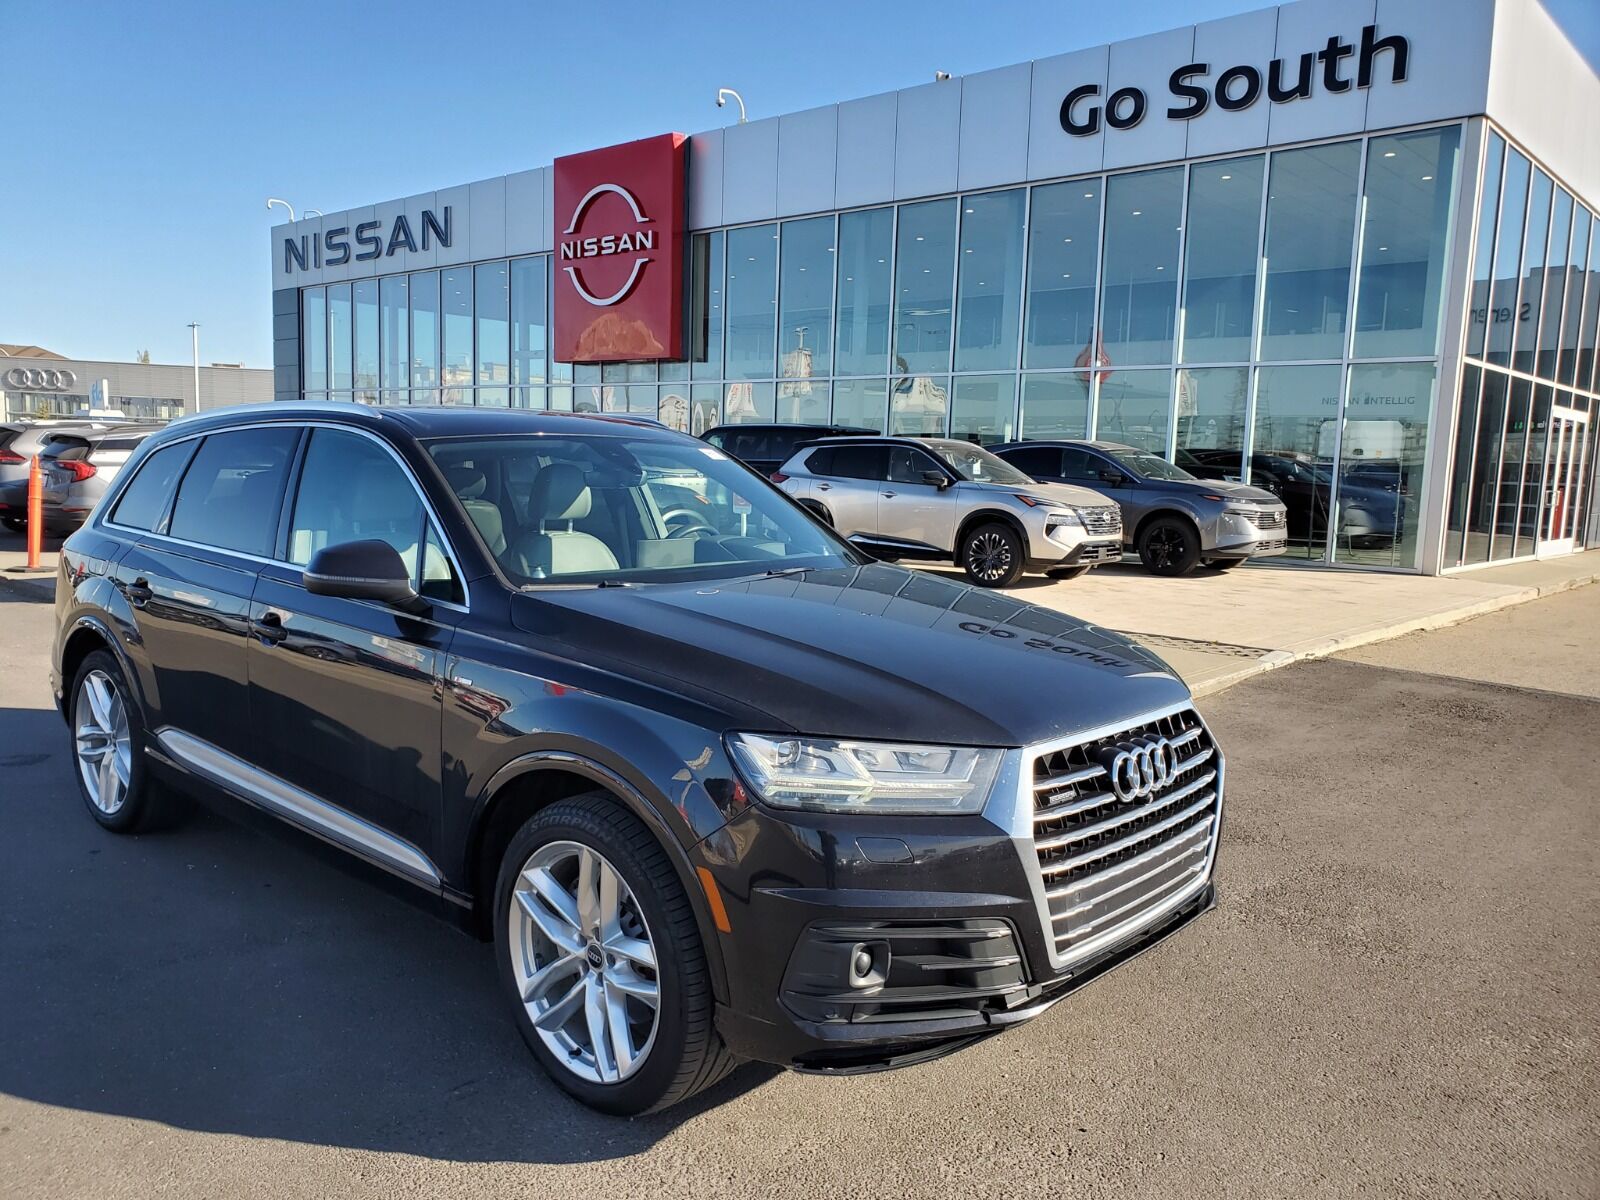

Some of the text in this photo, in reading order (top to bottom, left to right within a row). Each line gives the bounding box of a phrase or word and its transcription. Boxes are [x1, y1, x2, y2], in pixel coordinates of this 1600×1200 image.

[1059, 24, 1411, 137] Go South
[284, 205, 453, 274] NISSAN
[561, 230, 655, 261] NISSAN
